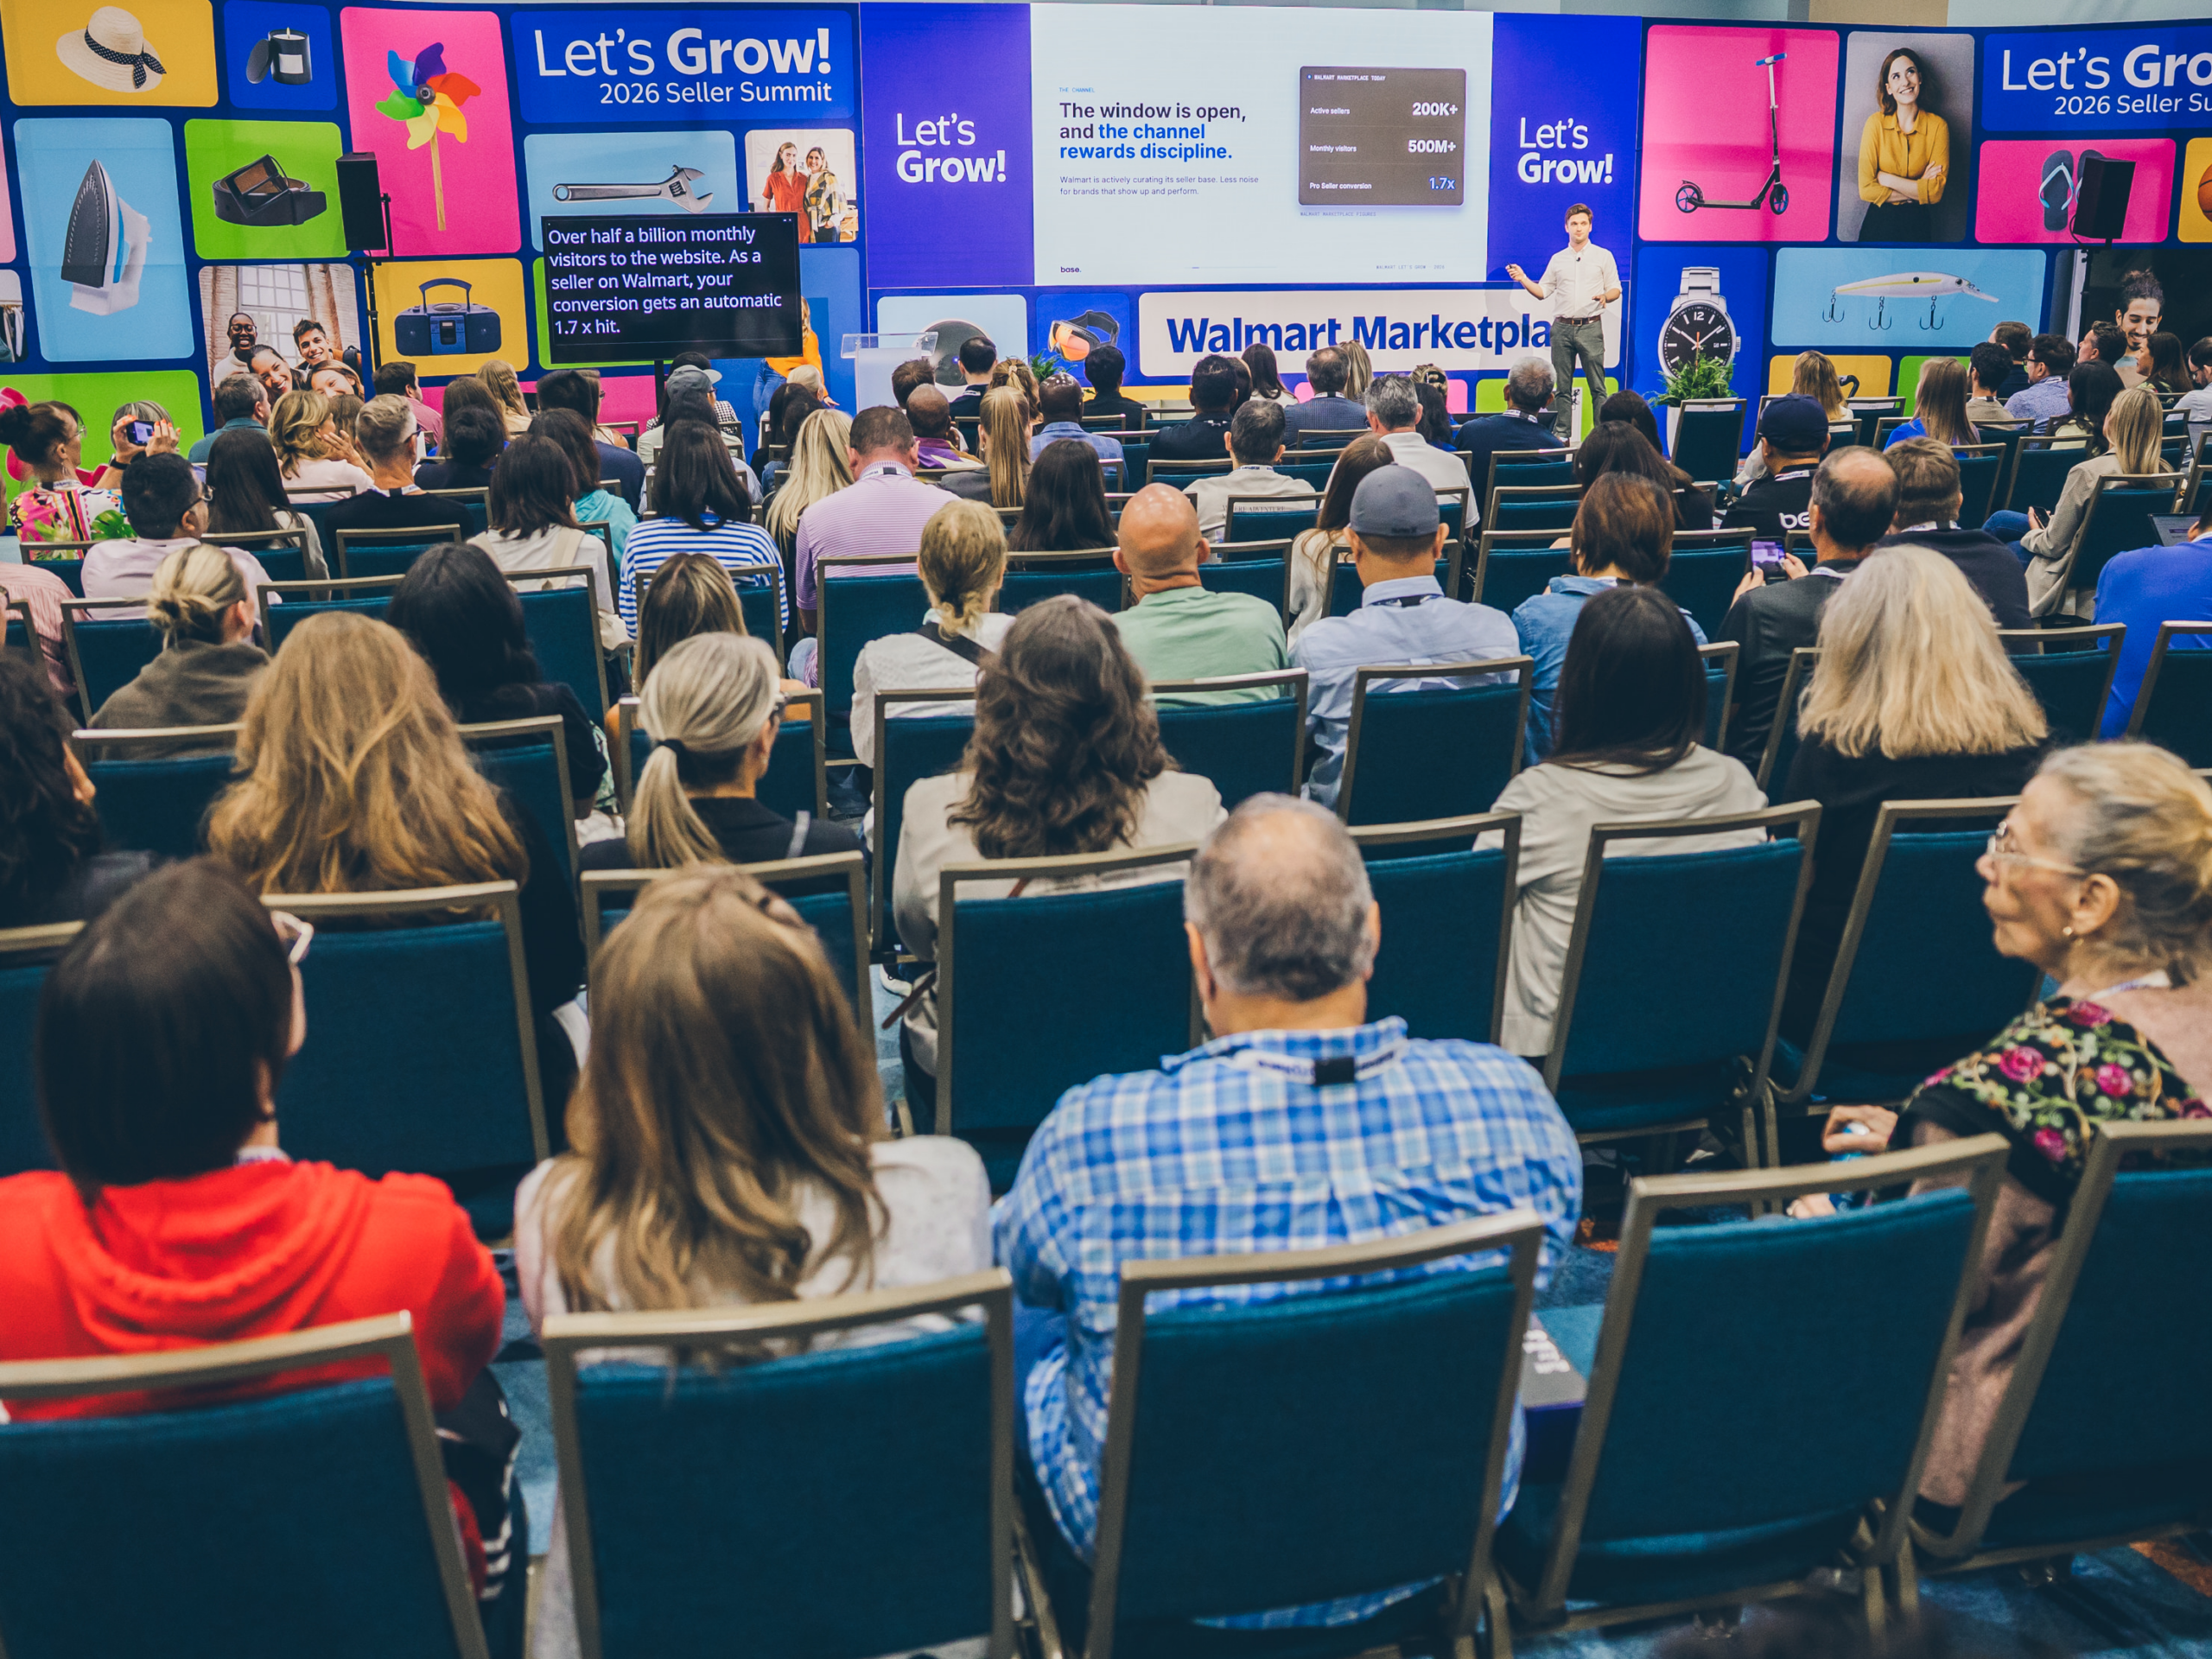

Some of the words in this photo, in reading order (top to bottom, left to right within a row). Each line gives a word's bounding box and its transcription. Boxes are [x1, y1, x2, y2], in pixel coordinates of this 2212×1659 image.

[535, 29, 655, 76] Let's
[666, 28, 831, 74] Grow!
[2002, 48, 2110, 92] Let's
[600, 84, 659, 104] 2026
[666, 82, 734, 103] Seller
[741, 81, 831, 102] Summit
[1059, 103, 1095, 118] The
[1100, 103, 1172, 118] window
[1176, 103, 1191, 118] is
[1196, 106, 1246, 122] open,
[1412, 101, 1458, 116] 200K+
[2054, 96, 2110, 115] 2026
[2116, 94, 2183, 114] Seller
[896, 113, 976, 146] Let's
[1059, 124, 1094, 139] and
[1098, 124, 1128, 139] the
[1133, 124, 1205, 139] channel
[1519, 118, 1589, 149] Let's
[1059, 143, 1135, 159] rewards
[1140, 143, 1232, 162] discipline.
[1310, 144, 1334, 153] Monthly
[1408, 139, 1456, 154] 500M+
[896, 150, 1007, 183] Grow!
[1517, 154, 1613, 184] Grow!
[1060, 175, 1091, 184] Walmart
[1102, 175, 1130, 185] actively
[1133, 175, 1163, 185] curating
[1165, 175, 1173, 184] its
[1176, 175, 1196, 184] seller
[1198, 175, 1218, 184] base.
[1220, 175, 1236, 184] Less
[1239, 175, 1259, 184] noise
[1429, 177, 1455, 190] 1.7x
[1101, 187, 1116, 195] that
[1140, 188, 1149, 197] up
[1167, 187, 1199, 197] perform.
[549, 230, 587, 245] Over
[591, 228, 622, 245] half
[625, 232, 634, 243] a
[639, 227, 686, 243] billion
[691, 226, 755, 245] monthly
[550, 251, 607, 266] visitors
[610, 252, 626, 265] to
[630, 251, 656, 264] the
[661, 250, 725, 264] website.
[729, 250, 748, 263] As
[753, 251, 761, 263] a
[551, 274, 594, 289] seller
[598, 276, 618, 289] on
[622, 273, 693, 289] Walmart,
[696, 273, 733, 289] your
[553, 296, 639, 312] conversion
[643, 297, 677, 314] gets
[680, 297, 700, 309] an
[703, 294, 782, 309] automatic
[1694, 312, 1704, 321] 12
[555, 321, 577, 334] 1.7
[581, 322, 592, 334] x
[595, 319, 620, 334] hit.
[1166, 317, 1341, 353] Walmart
[1352, 313, 1552, 355] Marketpla
